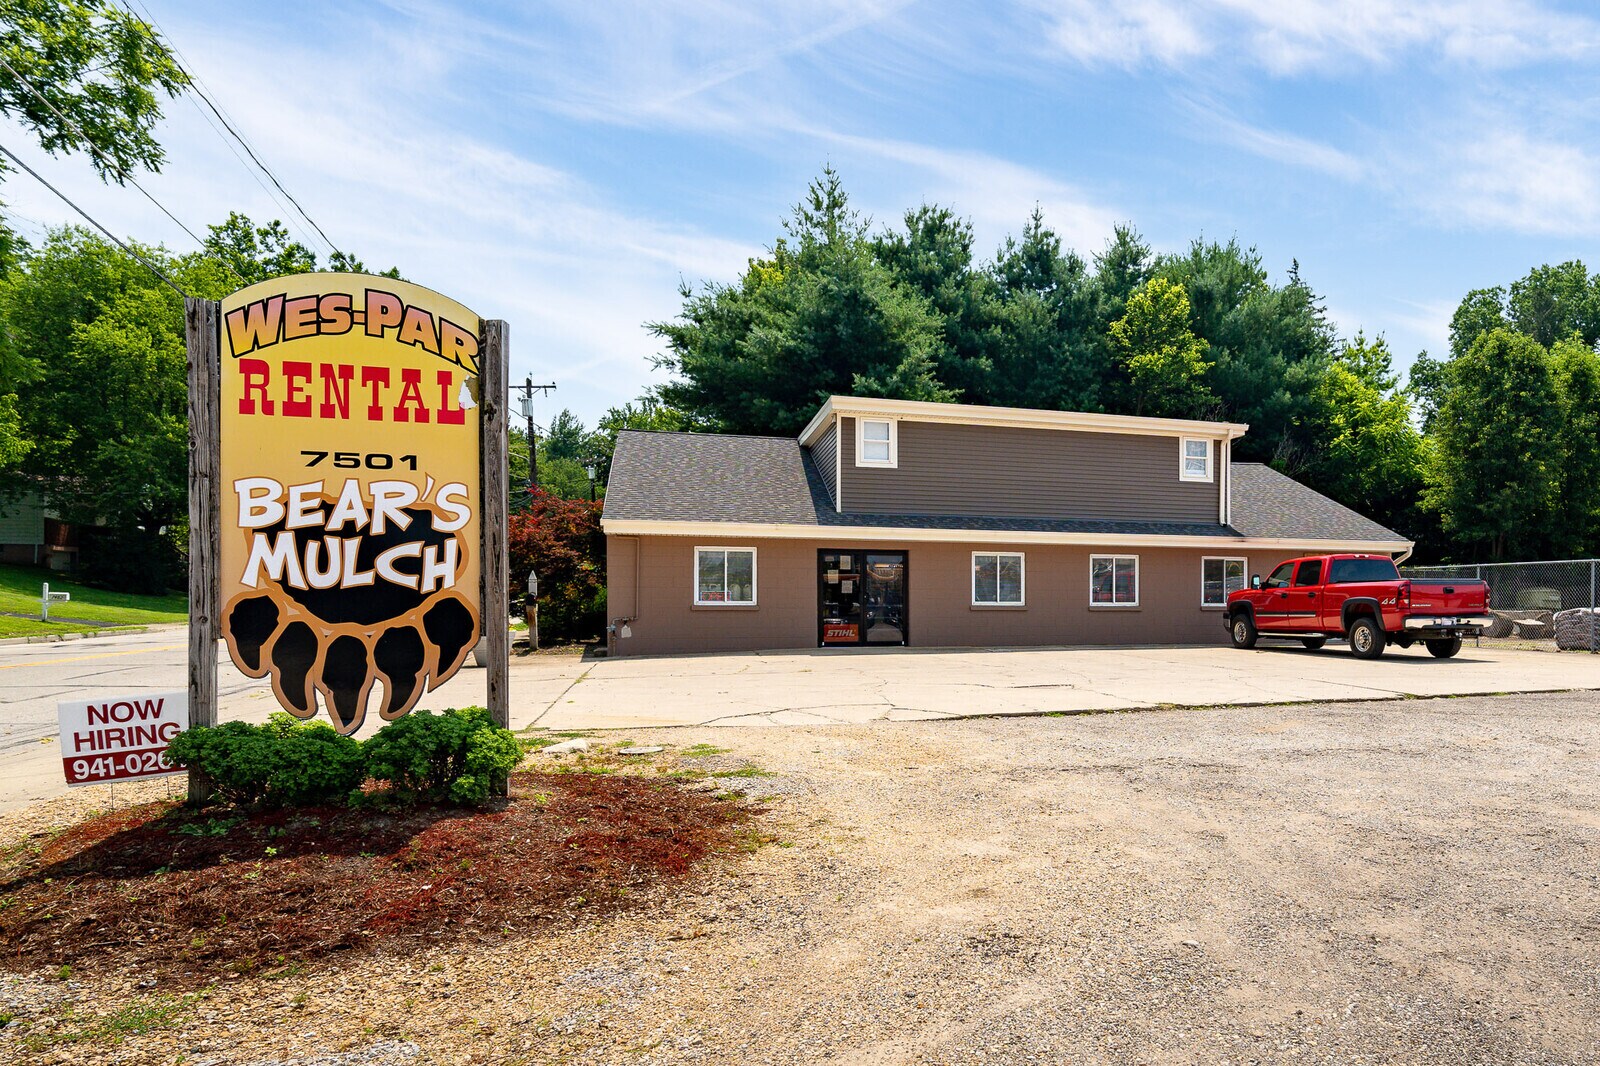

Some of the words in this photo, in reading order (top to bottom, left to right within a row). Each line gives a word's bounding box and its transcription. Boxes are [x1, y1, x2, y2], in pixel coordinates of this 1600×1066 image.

[224, 288, 480, 376] WES-PAR
[238, 358, 466, 425] RENTAL
[300, 450, 418, 471] 7501
[233, 472, 472, 536] BEAR'S
[239, 530, 459, 594] MULCH
[826, 629, 856, 637] STIHL
[87, 698, 165, 726] NOW
[73, 722, 182, 753] HIRING
[72, 750, 187, 780] 941-026
